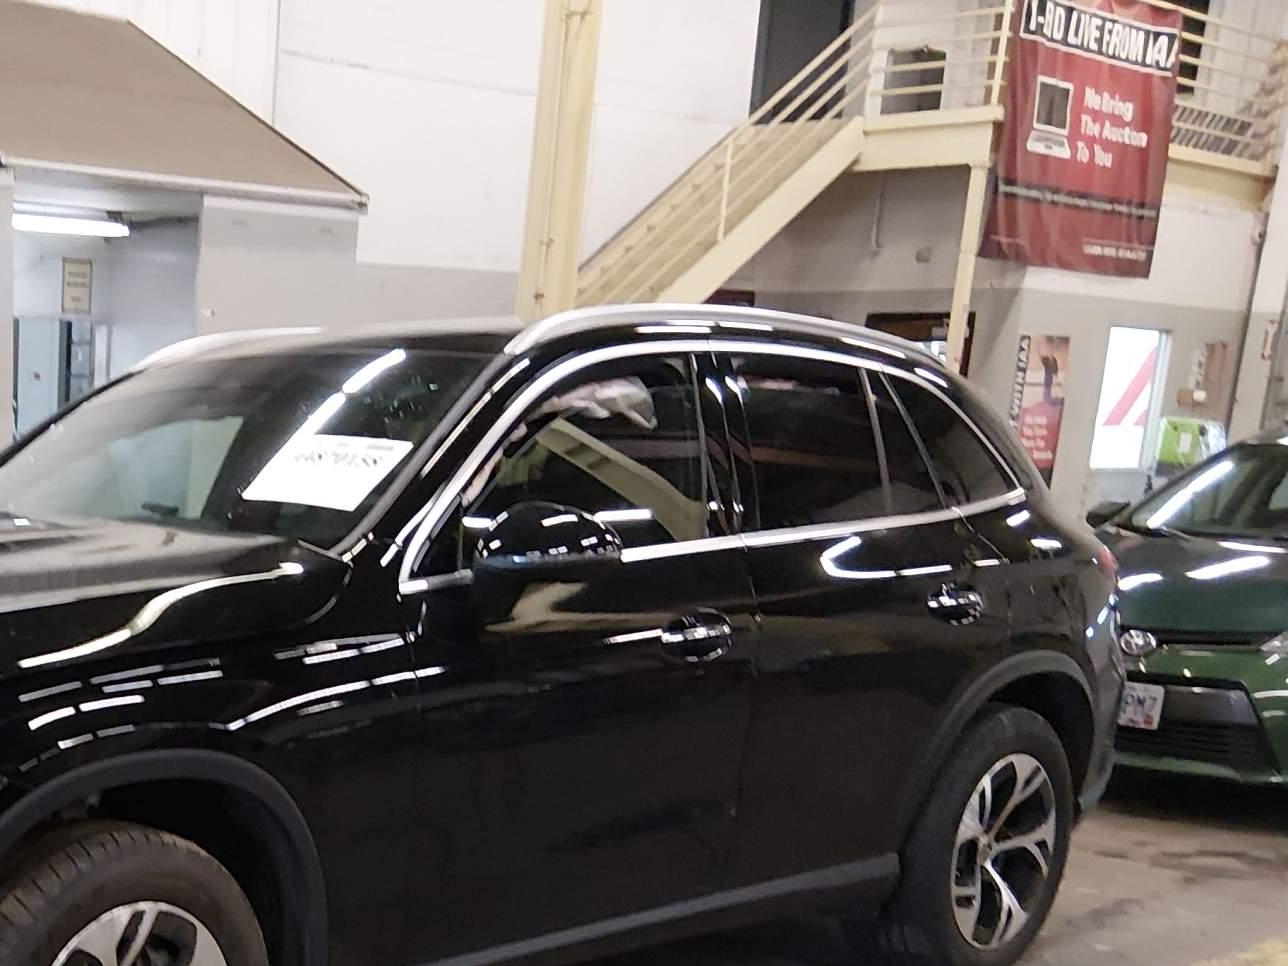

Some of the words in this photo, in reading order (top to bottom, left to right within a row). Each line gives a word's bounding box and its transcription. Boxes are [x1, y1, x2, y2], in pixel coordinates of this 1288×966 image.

[1102, 21, 1145, 63] FROM
[1080, 114, 1101, 139] The
[1076, 141, 1090, 164] To
[1094, 144, 1113, 168] You
